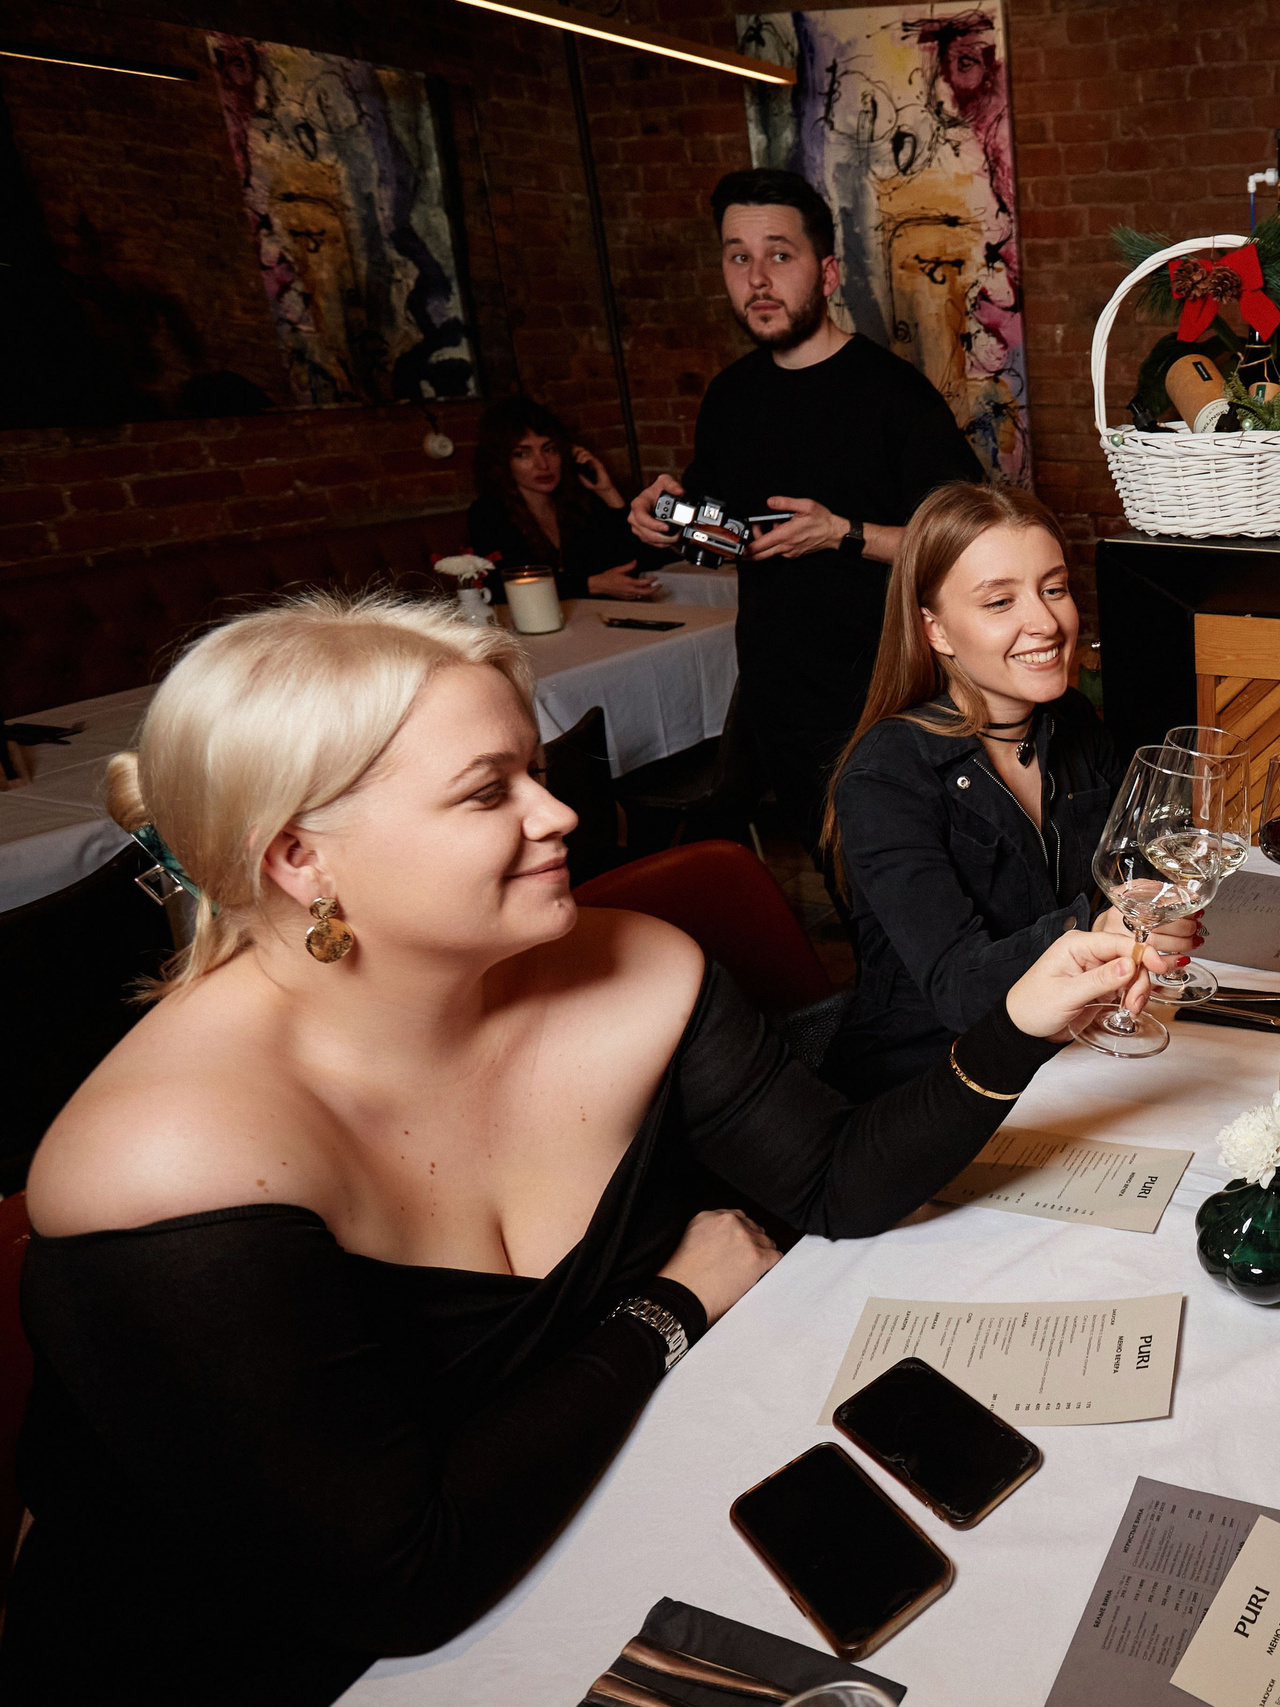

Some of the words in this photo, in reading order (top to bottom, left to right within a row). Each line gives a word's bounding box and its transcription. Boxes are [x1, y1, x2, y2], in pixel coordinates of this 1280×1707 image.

[1137, 1176, 1158, 1199] PURI
[1116, 1335, 1124, 1353] МЕНЮ
[1136, 1335, 1153, 1370] PURI
[1113, 1354, 1121, 1374] ВЕЧЕРА
[1093, 1607, 1106, 1628] БЕЛЫЕ
[1101, 1590, 1113, 1607] ВИНА
[1234, 1586, 1270, 1638] PURI
